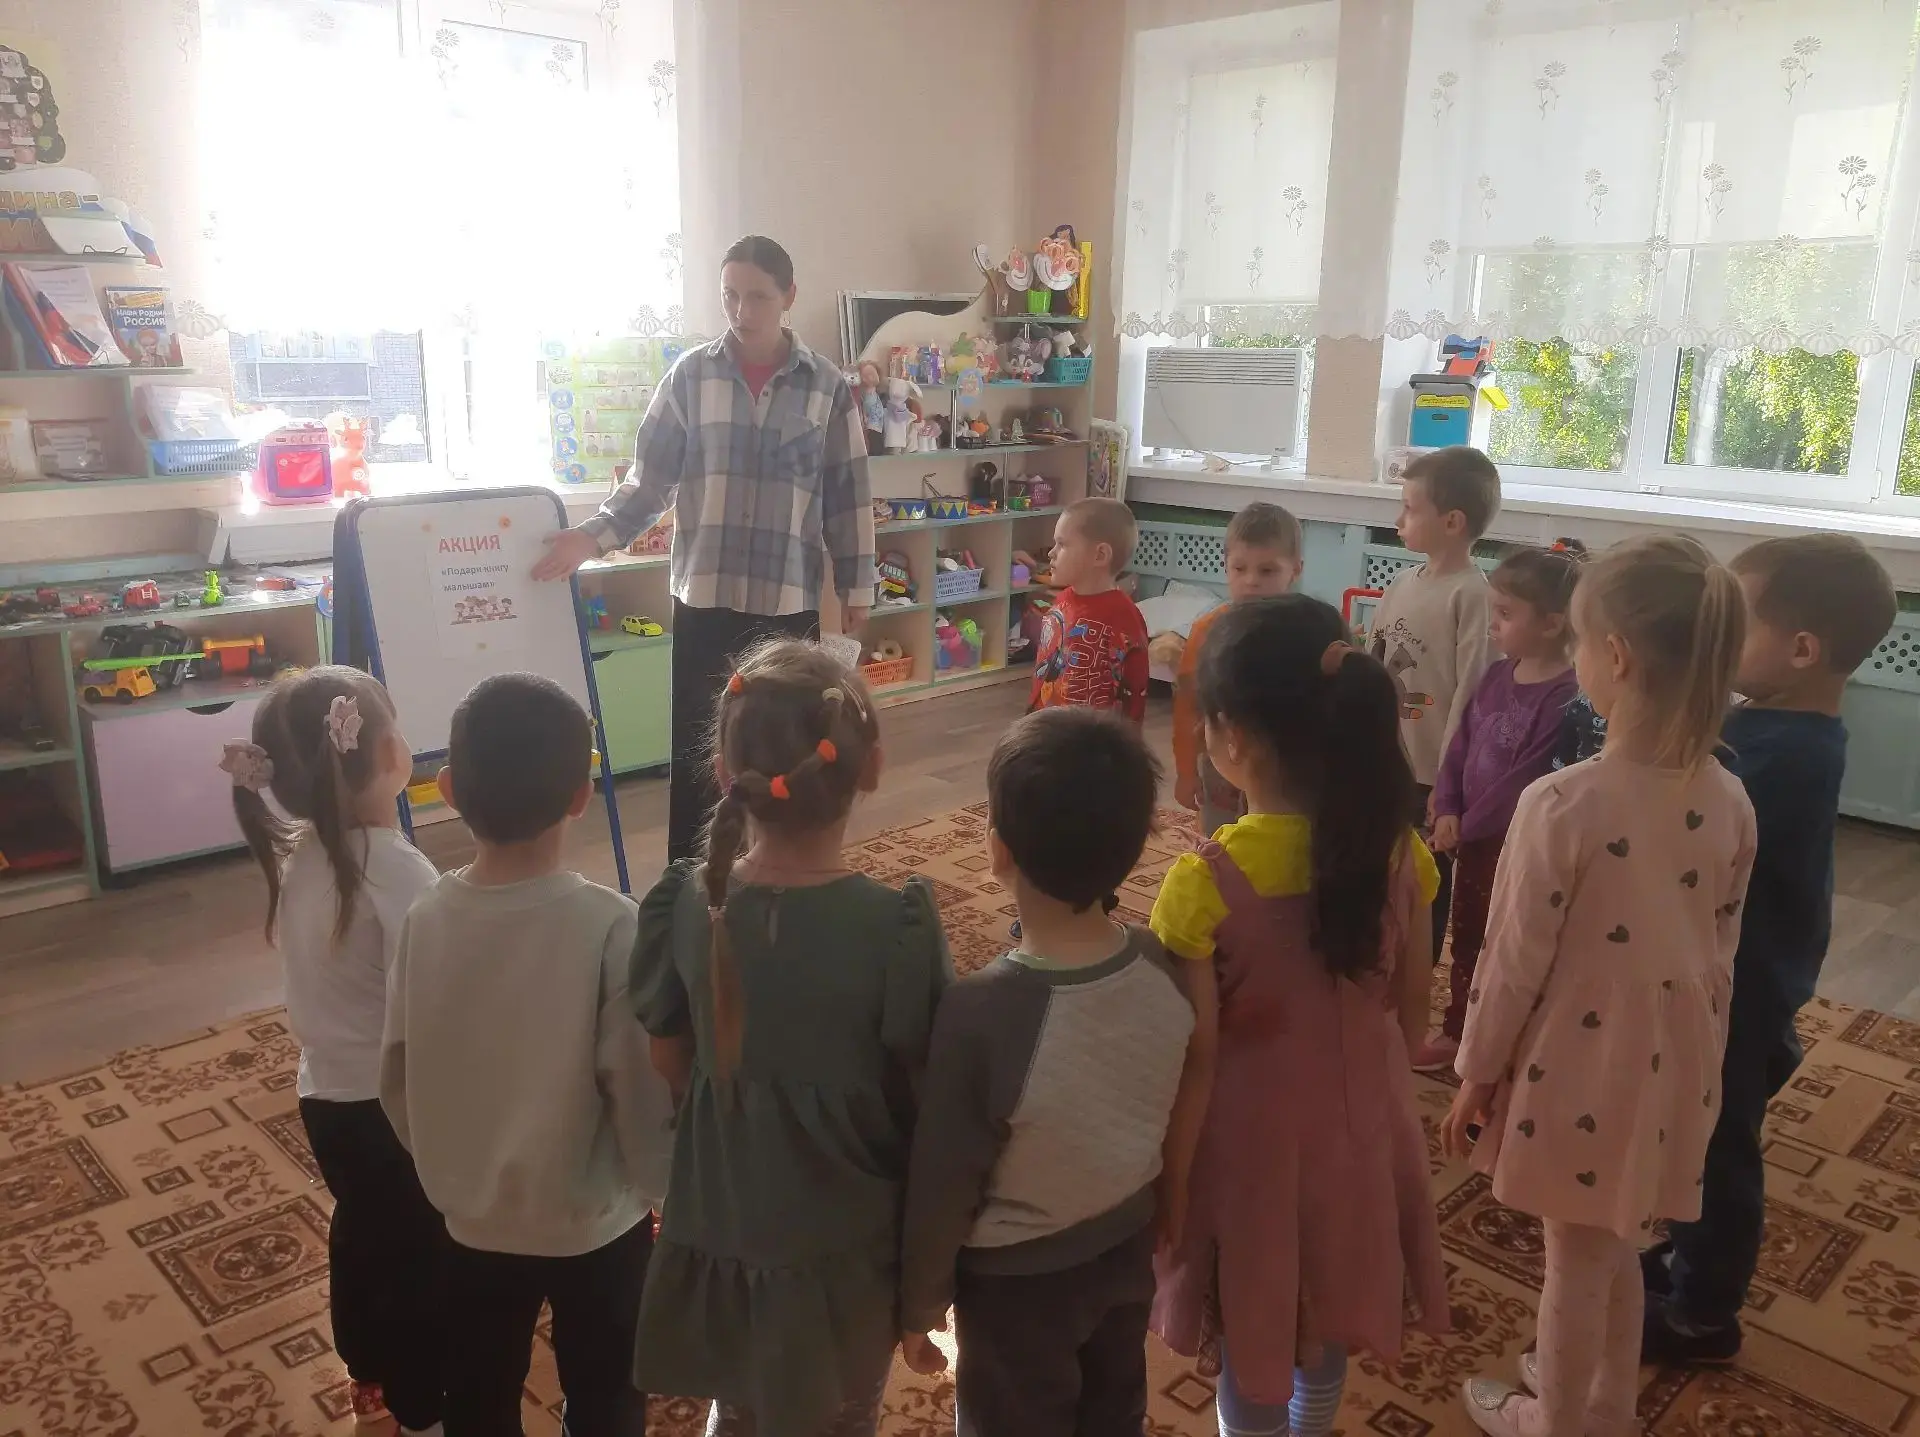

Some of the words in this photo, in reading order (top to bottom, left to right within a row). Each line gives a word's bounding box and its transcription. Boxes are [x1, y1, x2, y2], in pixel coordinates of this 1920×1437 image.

[439, 535, 501, 555] АКЦИЯ
[441, 566, 482, 577] «Подари
[484, 564, 509, 574] книгу
[444, 581, 495, 592] малышам»
